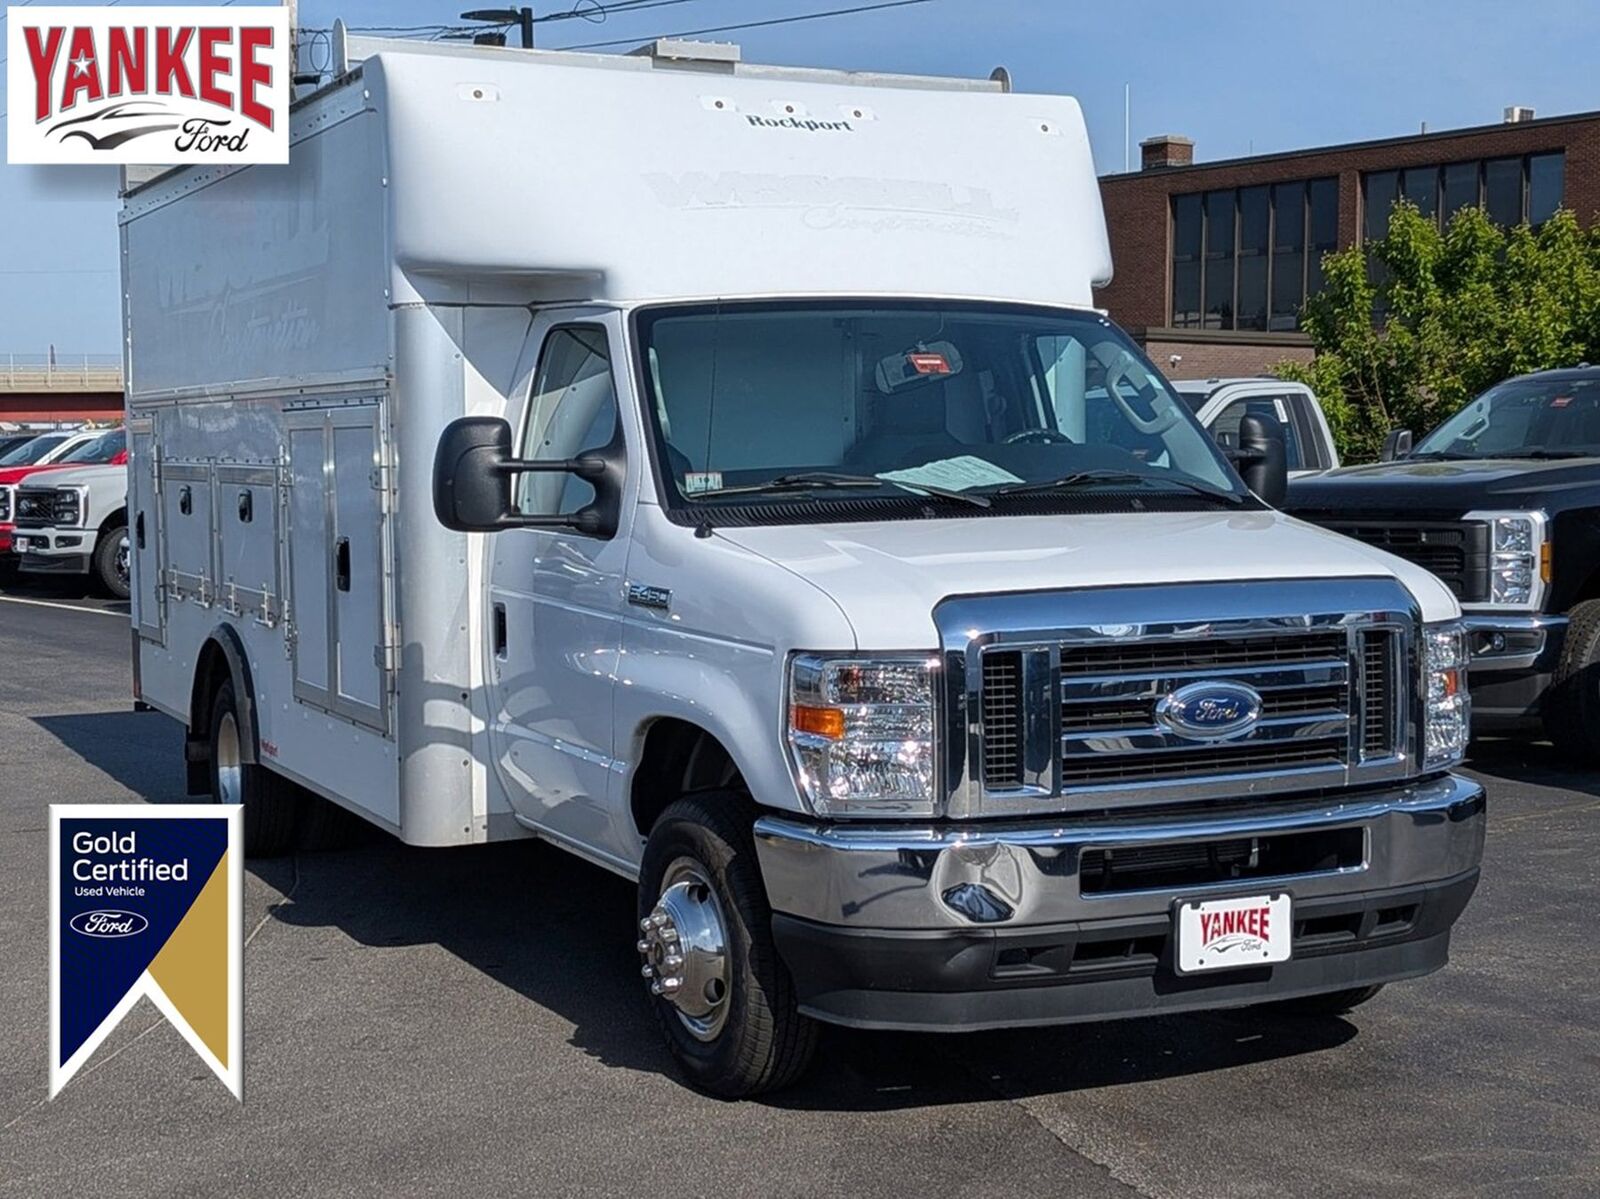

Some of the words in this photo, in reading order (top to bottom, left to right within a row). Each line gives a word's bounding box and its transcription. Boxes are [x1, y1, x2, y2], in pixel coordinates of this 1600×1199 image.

[746, 114, 854, 132] Rockport
[1195, 698, 1239, 720] Ford
[1200, 907, 1270, 947] YANKEE
